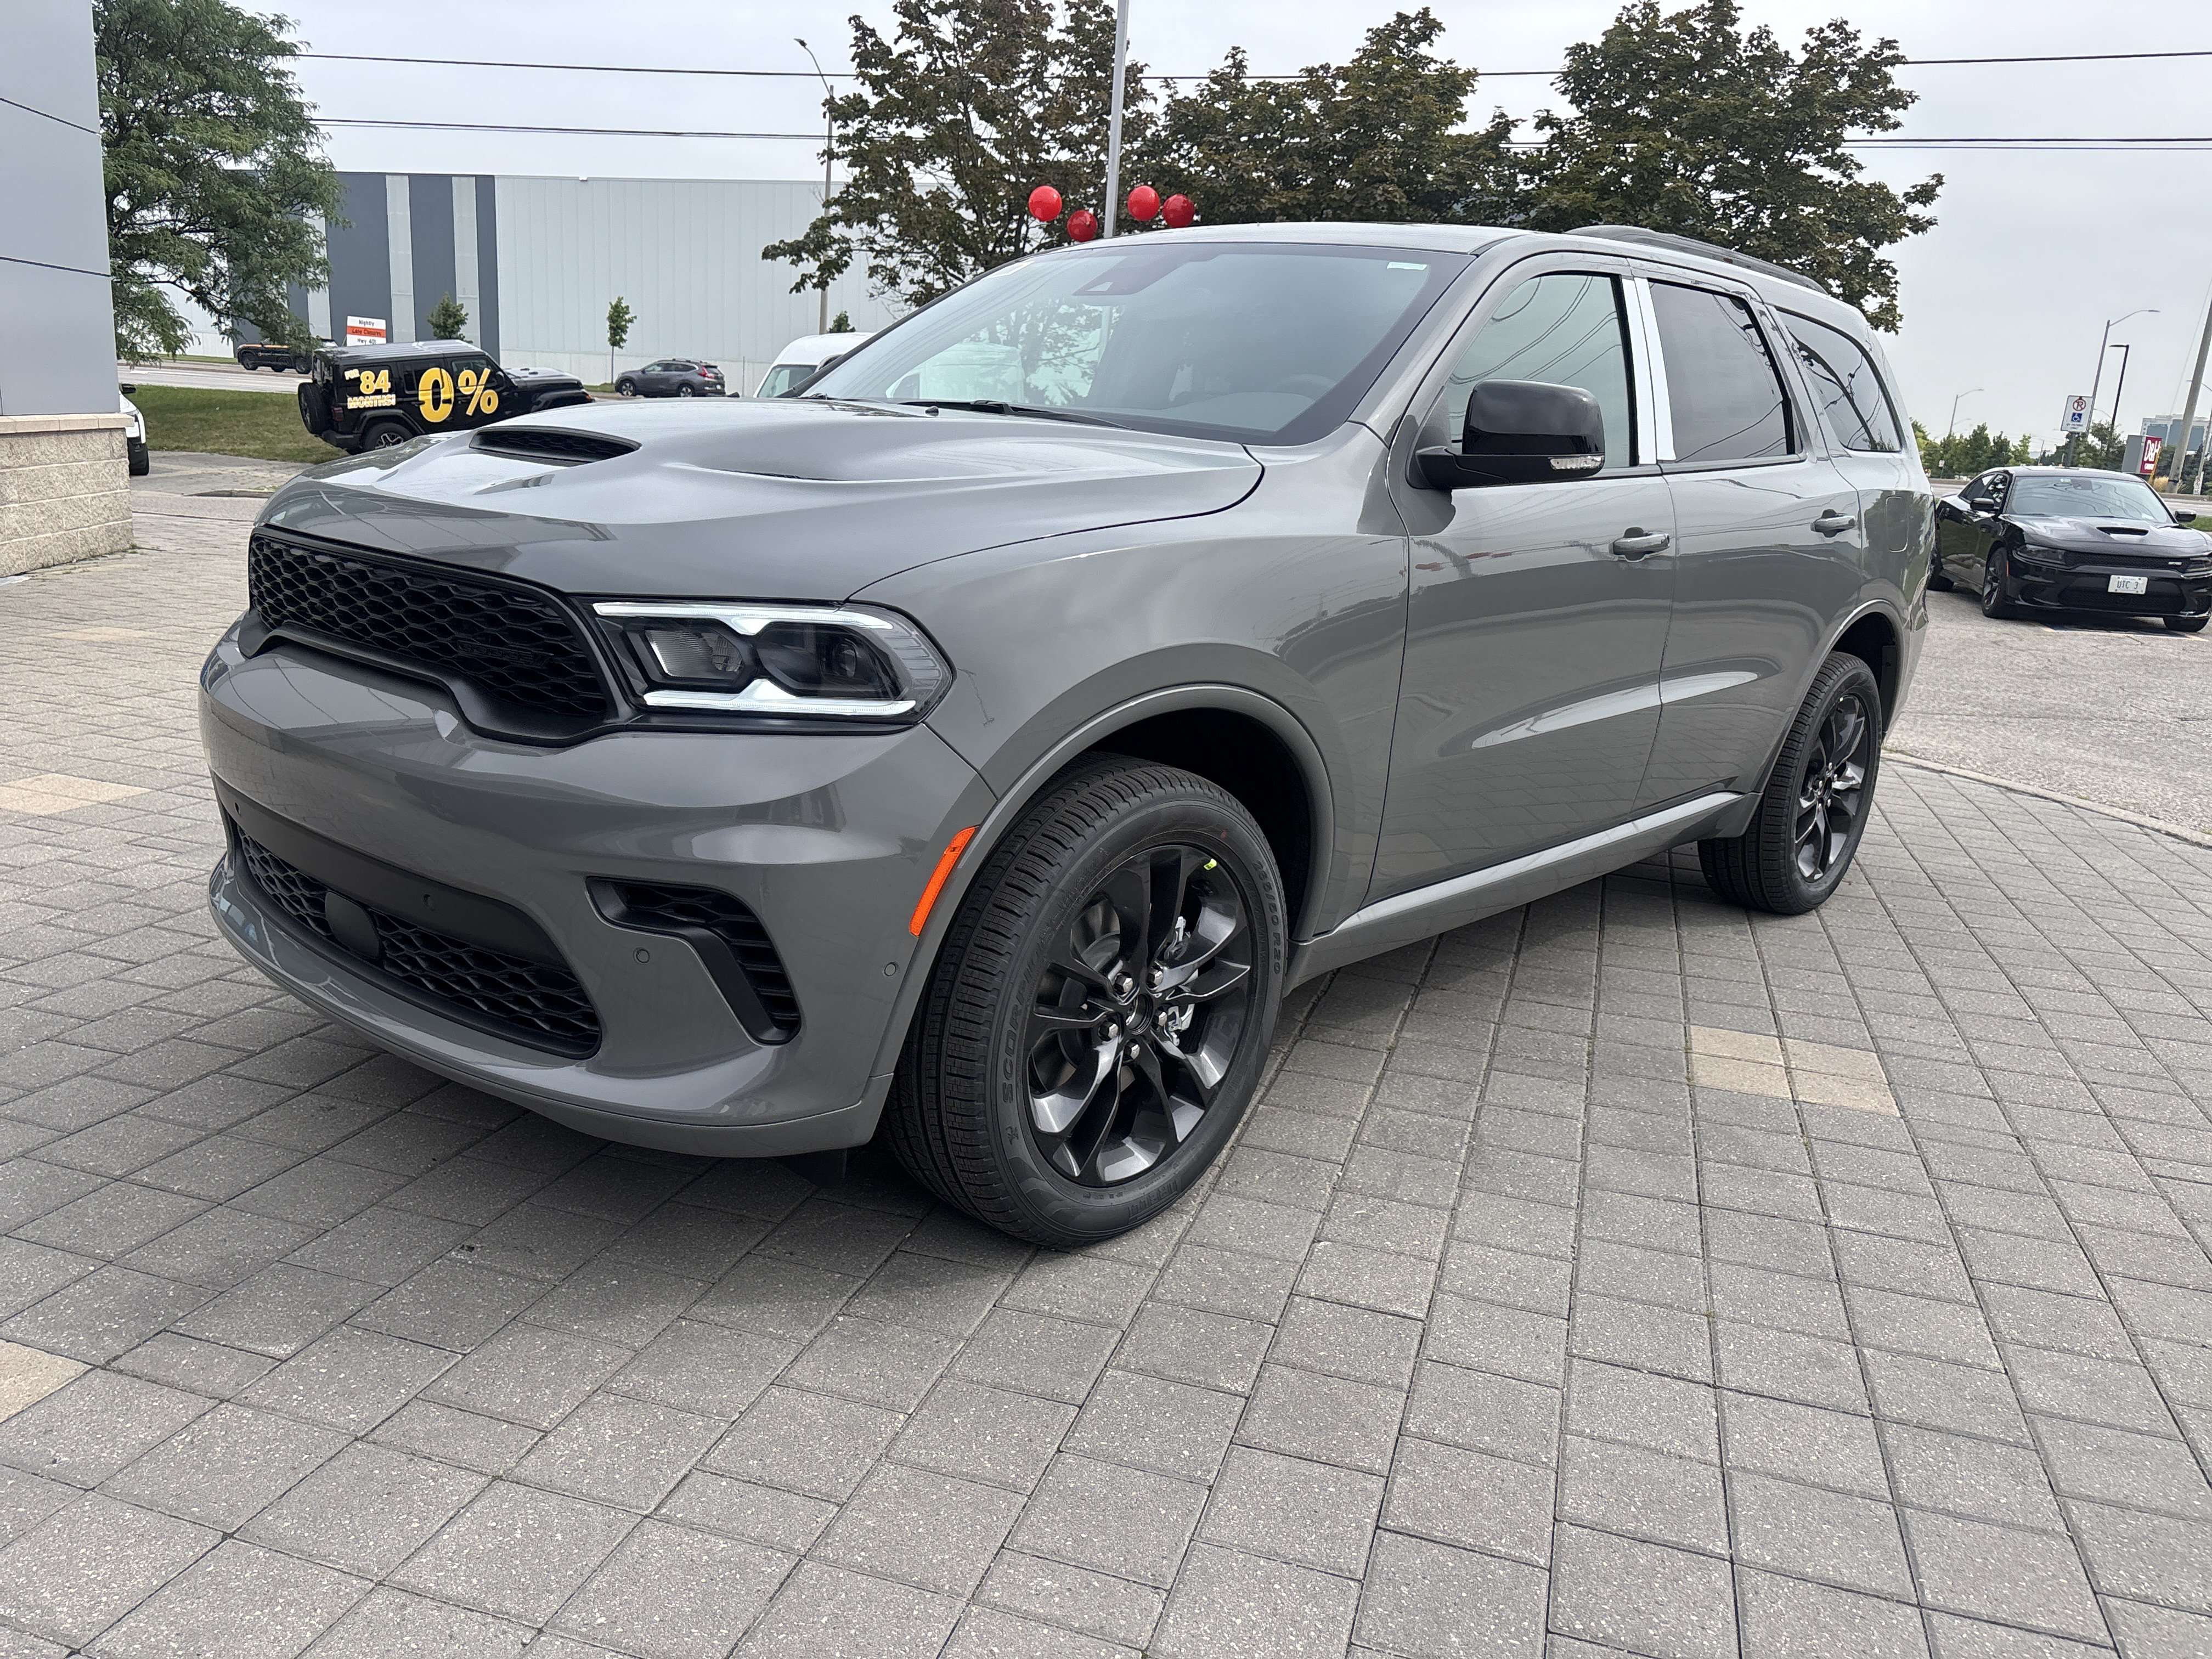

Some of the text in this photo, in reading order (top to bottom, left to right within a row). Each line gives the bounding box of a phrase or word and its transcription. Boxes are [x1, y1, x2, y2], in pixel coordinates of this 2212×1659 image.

[359, 369, 391, 394] 84
[419, 367, 499, 423] 0%
[2143, 439, 2162, 461] D&H
[1272, 932, 1281, 975] R20
